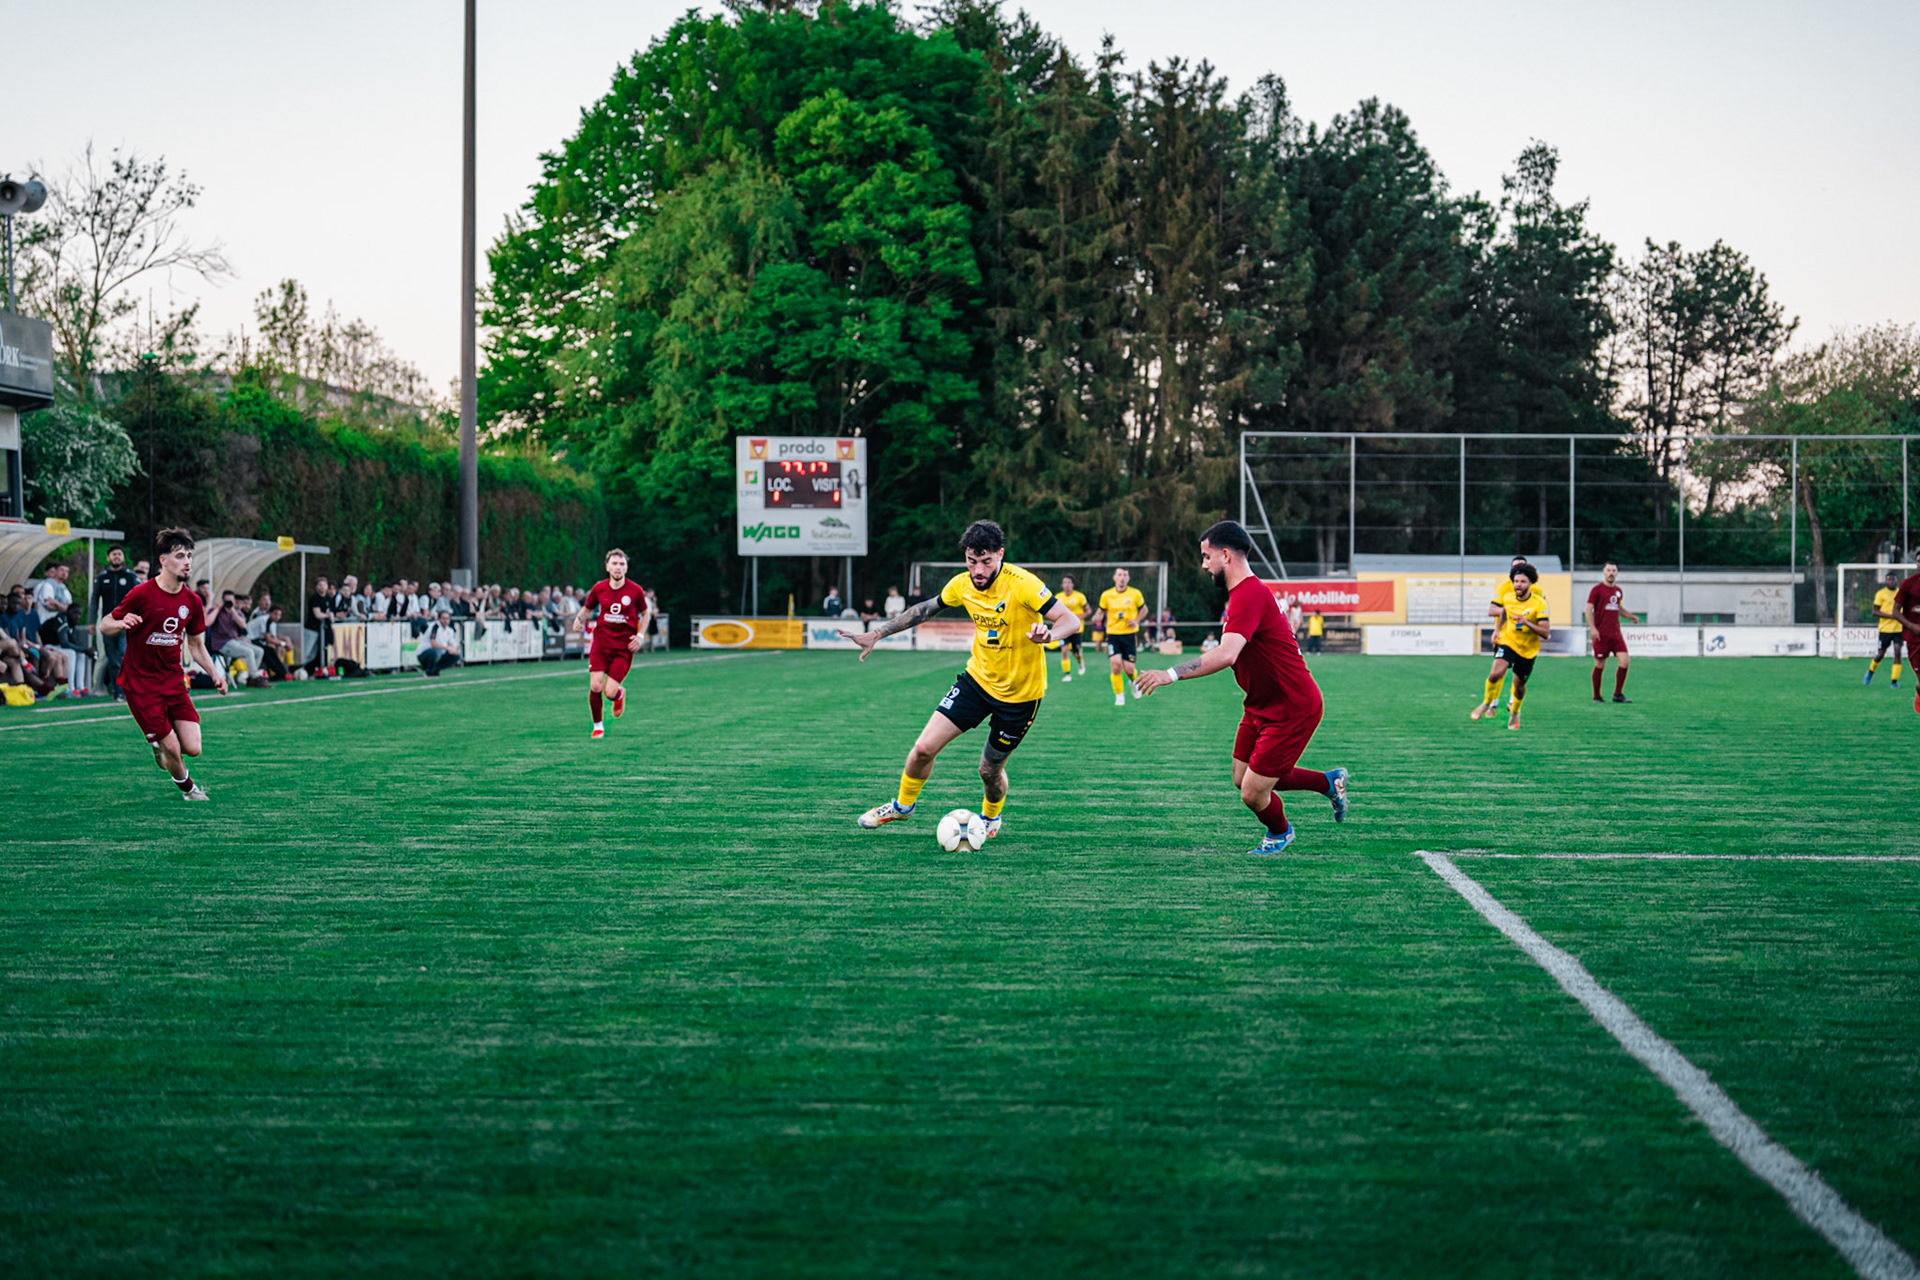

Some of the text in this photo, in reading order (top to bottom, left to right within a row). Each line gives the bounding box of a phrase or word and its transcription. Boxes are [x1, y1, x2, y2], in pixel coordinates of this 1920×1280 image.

[779, 440, 826, 456] prodo
[743, 521, 800, 543] WAGO
[1298, 591, 1360, 605] Mobilière
[1626, 632, 1668, 641] invictus
